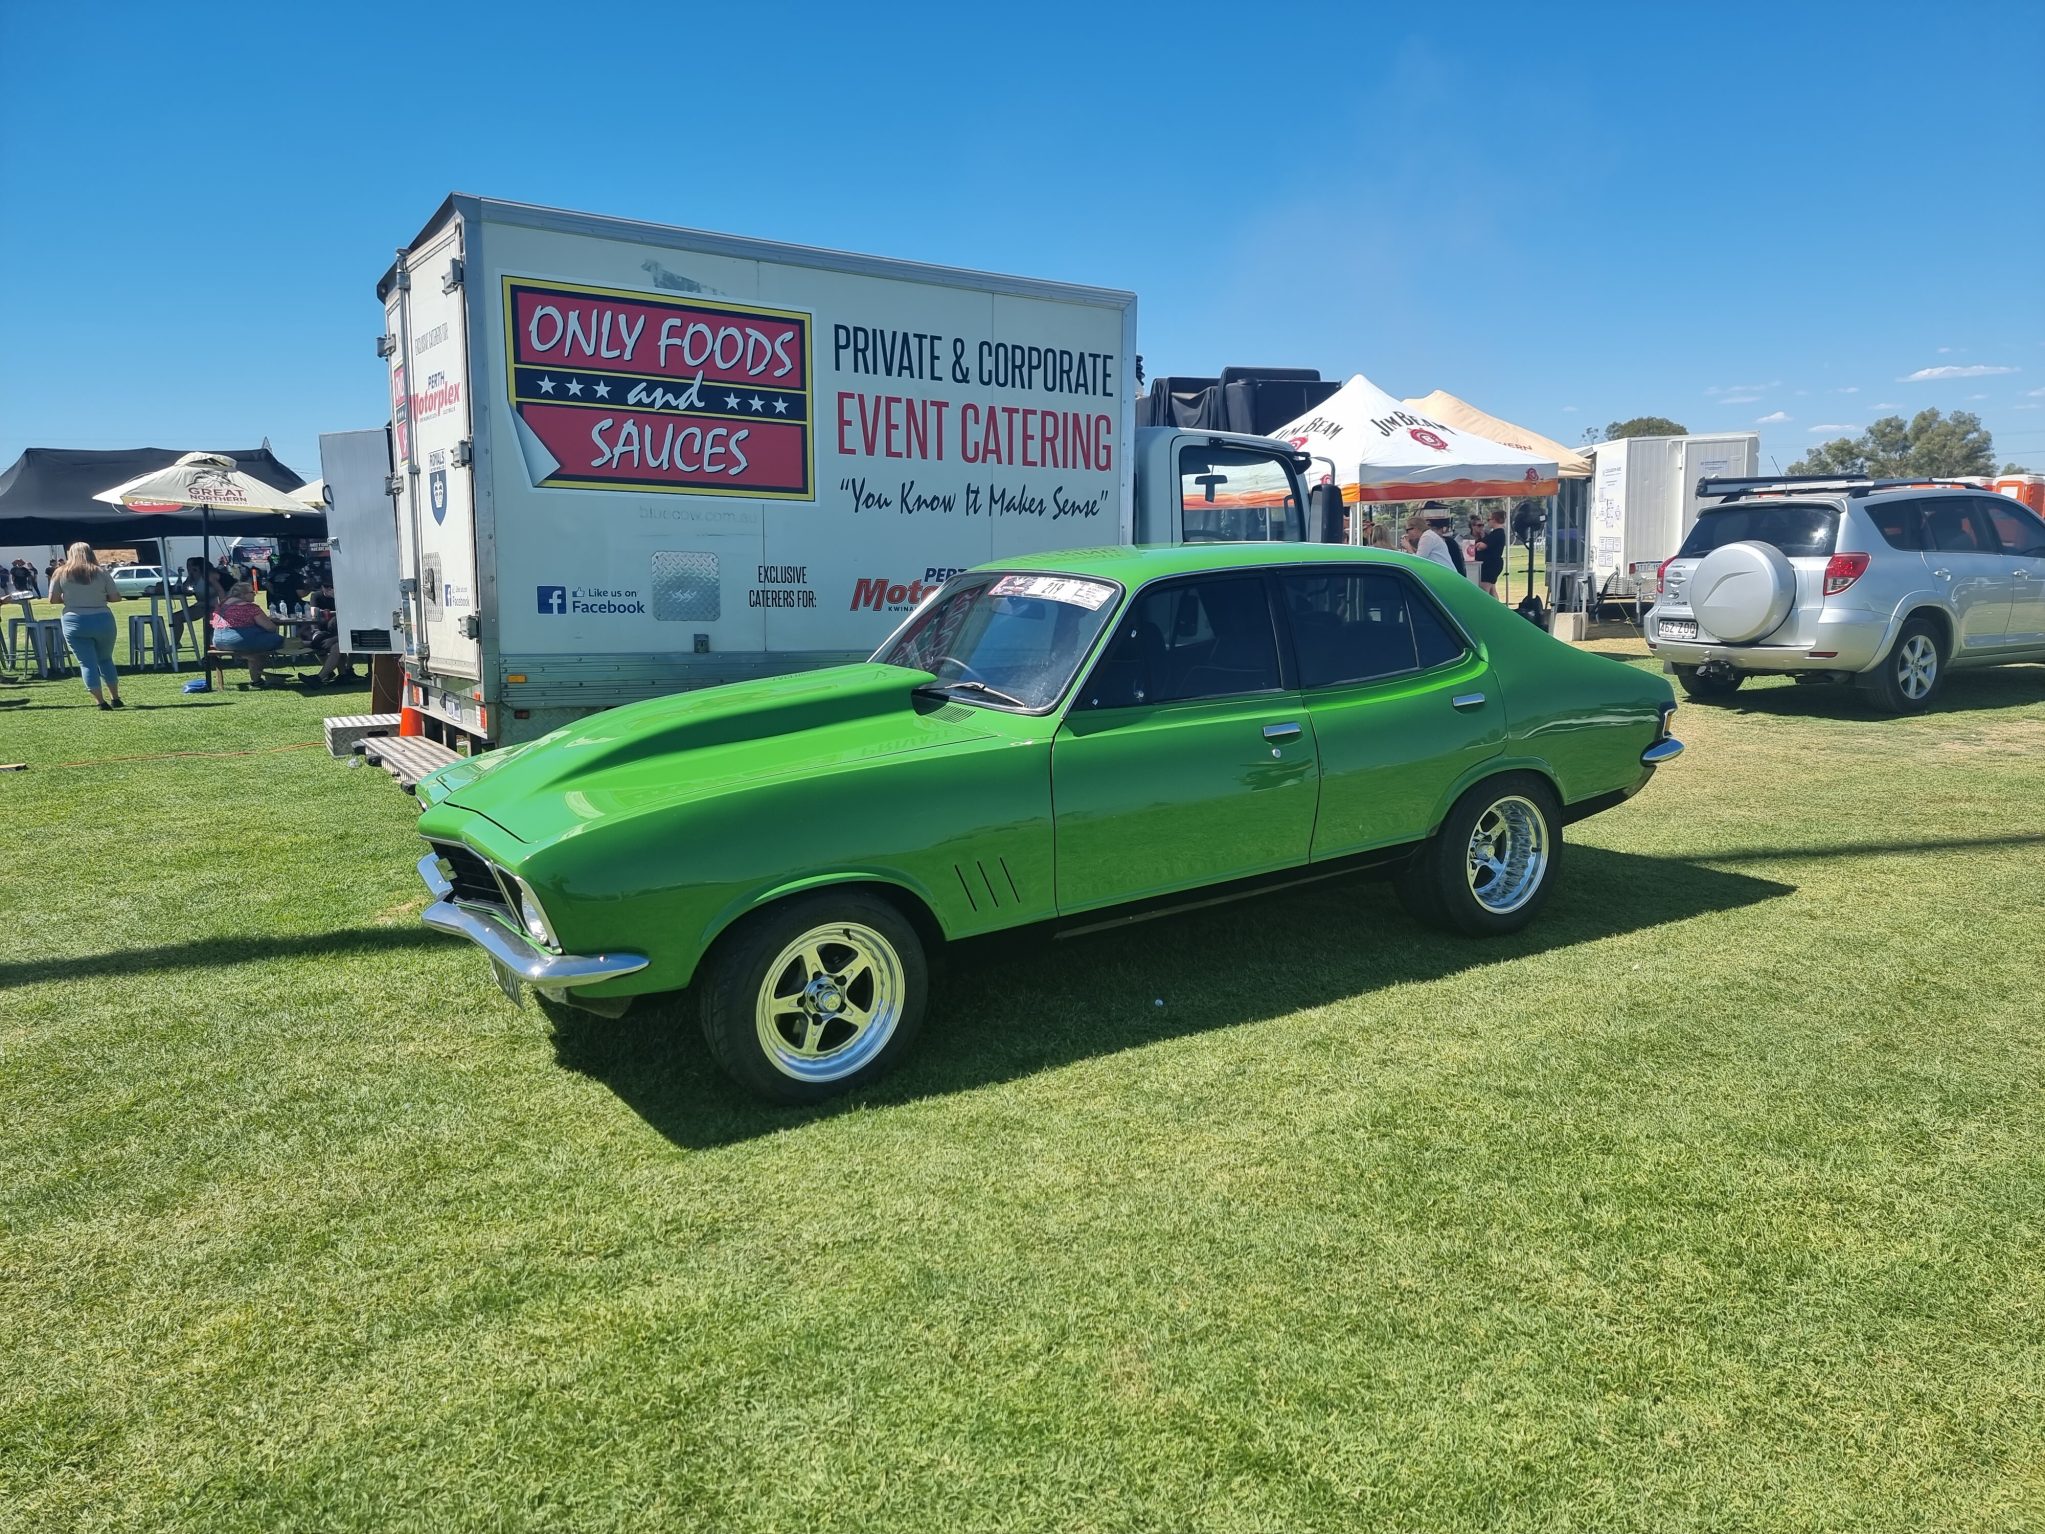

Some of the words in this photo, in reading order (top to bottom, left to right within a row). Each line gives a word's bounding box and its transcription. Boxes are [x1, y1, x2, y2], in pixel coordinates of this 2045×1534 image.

[529, 305, 646, 361] ONLY
[658, 318, 794, 378] FOODS
[834, 323, 943, 382] PRIVATE
[952, 337, 970, 384] &
[978, 340, 1114, 397] CORPORATE
[428, 370, 445, 390] PERTH
[627, 370, 705, 410] and
[837, 391, 950, 461] EVENT
[961, 403, 1112, 472] CATERING
[1302, 417, 1344, 440] BEAM
[1370, 416, 1402, 437] JIM
[1392, 411, 1458, 436] BEAM
[591, 419, 749, 476] SAUCES
[188, 487, 245, 497] GREAT
[189, 494, 248, 503] NORTHERN
[900, 480, 956, 515] Know
[965, 483, 982, 516] It
[988, 484, 1047, 518] Makes
[758, 565, 807, 584] EXCLUSIVE
[924, 567, 968, 582] PER
[588, 588, 608, 597] Like
[611, 590, 622, 598] us
[624, 590, 637, 598] on
[749, 590, 795, 608] CATERERS
[797, 590, 817, 608] FOR:
[572, 600, 646, 614] Facebook
